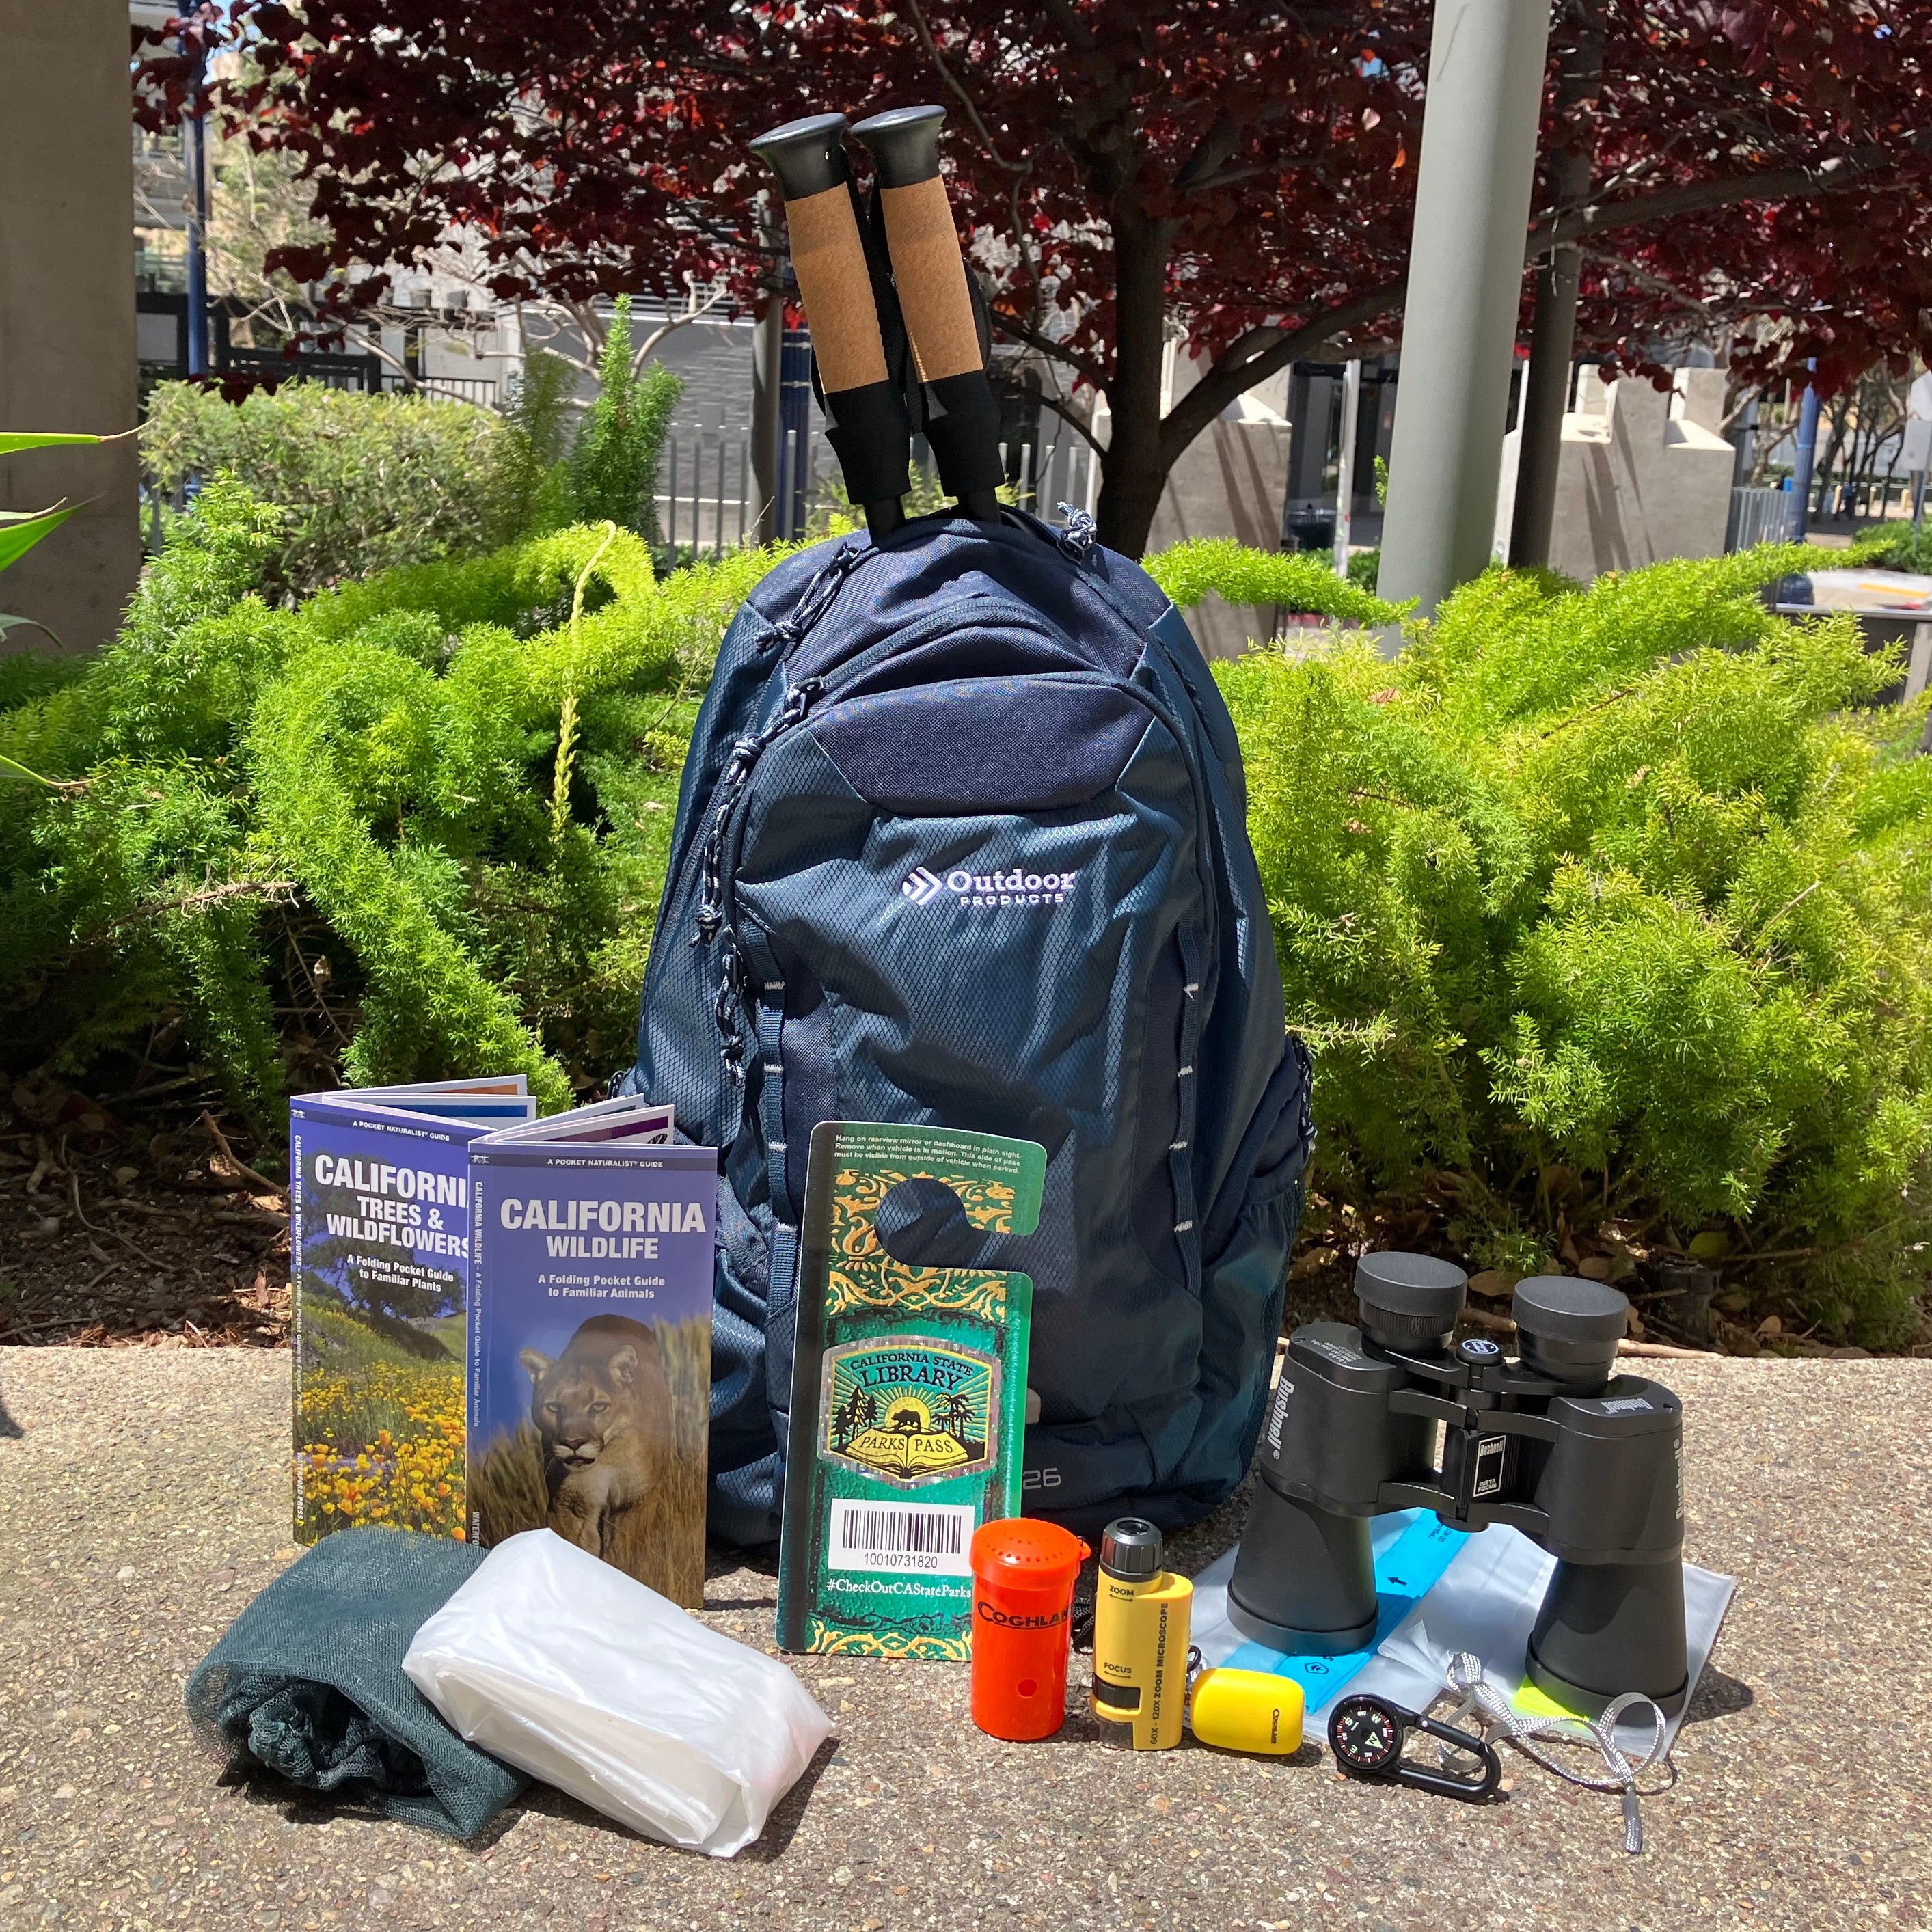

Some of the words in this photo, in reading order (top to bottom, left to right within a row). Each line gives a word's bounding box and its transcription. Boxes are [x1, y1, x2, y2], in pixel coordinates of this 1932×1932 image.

[947, 869, 1077, 893] Outdoor
[960, 893, 1064, 906] PRODUCTS
[359, 1121, 385, 1131] POCKET
[429, 1132, 450, 1141] GUIDE
[836, 1134, 855, 1143] Hang
[934, 1140, 972, 1150] dashboard
[931, 1148, 958, 1156] motion.
[1003, 1158, 1020, 1167] pass
[945, 1158, 971, 1166] vehicle
[972, 1161, 992, 1169] when
[993, 1165, 1019, 1173] parked.
[315, 1154, 468, 1208] CALIFORNI
[357, 1195, 421, 1227] TREES
[427, 1208, 444, 1230] &
[474, 1181, 483, 1227] CALIFORNIA
[500, 1198, 707, 1233] CALIFORNIA
[326, 1213, 468, 1259] WILDFLOWERS
[474, 1228, 482, 1264] WILDLIFE
[546, 1236, 659, 1260] WILDLIFE
[346, 1253, 354, 1264] A
[356, 1255, 391, 1273] Folding
[393, 1262, 425, 1277] Pocket
[427, 1268, 454, 1282] Guide
[475, 1273, 482, 1281] A
[359, 1268, 369, 1279] to
[372, 1270, 410, 1287] Familiar
[412, 1278, 442, 1292] Plants
[538, 1274, 546, 1284] A
[549, 1274, 590, 1287] Folding
[593, 1275, 631, 1286] Pocket
[634, 1275, 666, 1287] Guide
[474, 1282, 482, 1306] Folding
[548, 1286, 559, 1297] to
[562, 1287, 608, 1298] Familiar
[610, 1288, 655, 1299] Animals
[474, 1359, 480, 1367] to
[850, 1353, 929, 1370] CALIFORNIA
[933, 1356, 973, 1376] STATE
[860, 1365, 962, 1391] LIBRARY
[858, 1437, 905, 1450] PARKS
[914, 1439, 953, 1453] PASS
[1480, 1439, 1504, 1456] Bushnell
[1023, 1467, 1061, 1490] 26
[1478, 1482, 1497, 1493] FOCUS
[864, 1553, 938, 1568] 10010731820
[826, 1578, 972, 1599] #CheckOutCAStateParks
[1109, 1584, 1134, 1596] ZOOM
[1156, 1603, 1169, 1668] MICROSCOPE
[1104, 1662, 1132, 1674] FOCUS
[1154, 1670, 1164, 1698] ZOOM
[1152, 1700, 1160, 1722] 120X
[1371, 1713, 1382, 1724] W
[1345, 1717, 1353, 1726] S
[1150, 1728, 1158, 1745] 60X
[1369, 1736, 1378, 1745] N
[1350, 1745, 1358, 1754] E
